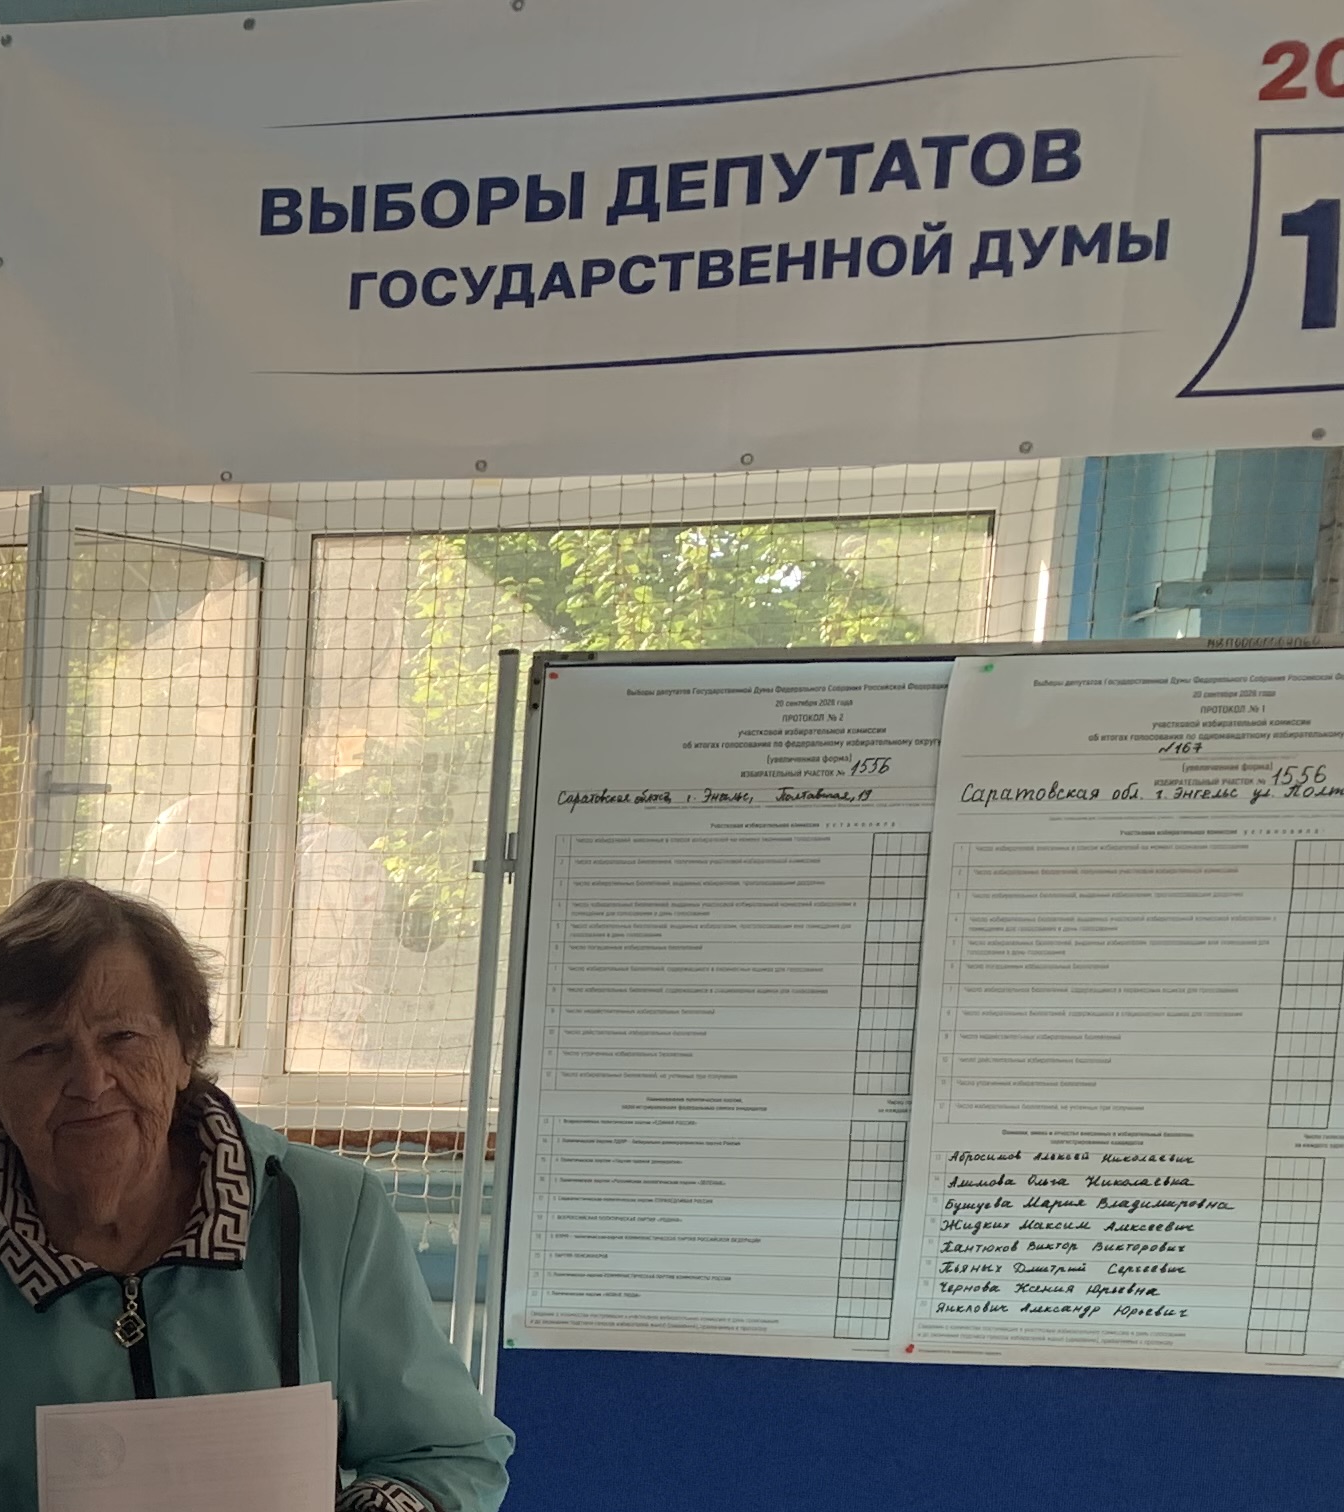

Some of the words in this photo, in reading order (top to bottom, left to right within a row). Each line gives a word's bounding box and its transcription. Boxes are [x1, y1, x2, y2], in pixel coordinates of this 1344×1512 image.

[260, 170, 586, 237] ВЫБОРЫ
[605, 127, 1082, 227] ДЕПУТАТОВ
[349, 222, 953, 311] ГОСУДАРСТВЕННОЙ
[968, 218, 1170, 280] ДУМЫ
[782, 713, 825, 723] ПРОТОКОЛ
[1200, 704, 1246, 714] ПРОТОКОЛ
[850, 757, 893, 777] 1556
[1271, 764, 1328, 787] 1556
[960, 780, 1101, 808] Саратовская
[1173, 786, 1240, 800] Энгельс
[947, 1150, 1022, 1166] Абросимов
[1100, 1153, 1196, 1164] Николаевич
[1027, 1174, 1070, 1187] Ольга
[1084, 1175, 1195, 1188] Николаевна
[1022, 1196, 1087, 1214] Мария
[1095, 1196, 1236, 1214] Владимировна
[940, 1219, 1011, 1236] Жидких
[1018, 1219, 1091, 1231] Максим
[1026, 1241, 1079, 1255] Виктор
[1091, 1241, 1186, 1255] Викторович
[1012, 1261, 1087, 1276] Дмитрий
[1107, 1262, 1187, 1277] Сергеевич
[938, 1280, 1001, 1296] Чернова
[1085, 1282, 1161, 1299] Юрьевна
[1019, 1302, 1101, 1319] Александр
[1112, 1304, 1189, 1320] Юрьевич
